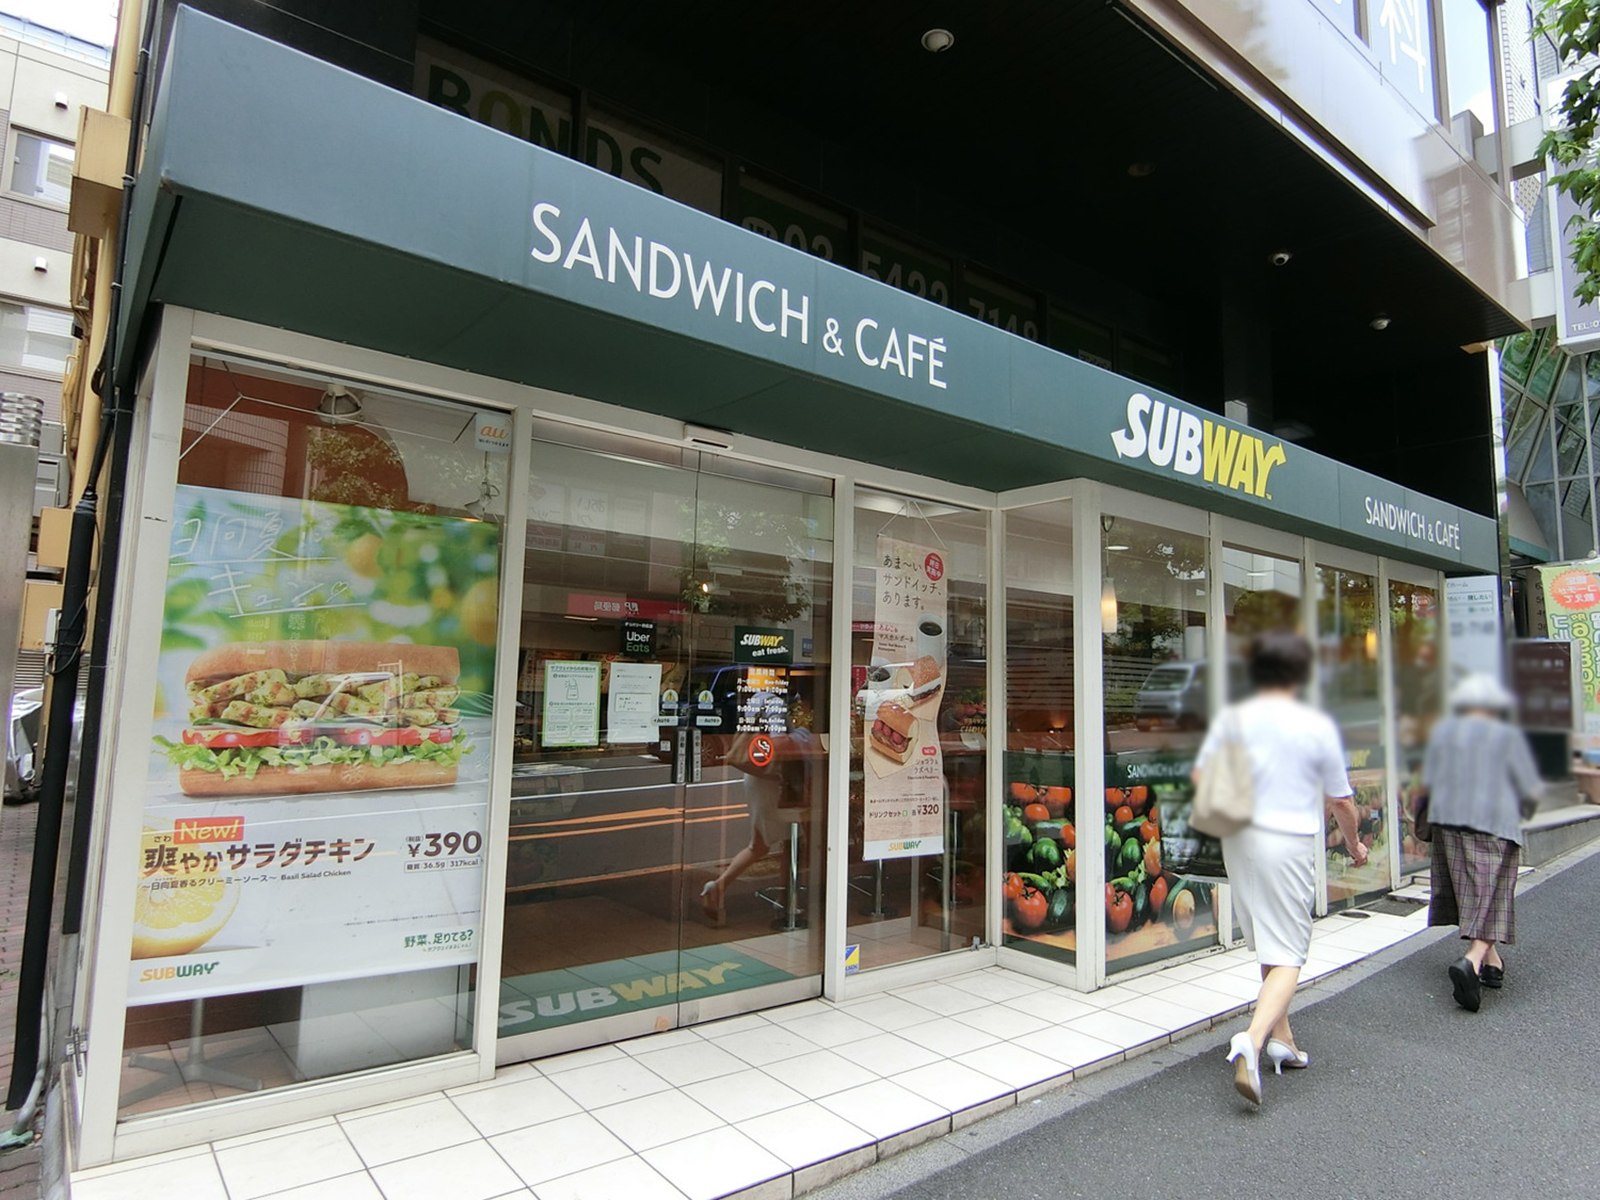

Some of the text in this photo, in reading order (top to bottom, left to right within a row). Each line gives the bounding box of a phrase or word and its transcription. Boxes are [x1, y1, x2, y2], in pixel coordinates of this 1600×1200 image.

[530, 201, 948, 389] SANDWICH & CAFÉ
[1110, 392, 1287, 499] SUBWAY
[1364, 495, 1461, 552] SANDWICH & CAFÉ
[626, 631, 651, 642] Uber
[740, 634, 784, 647] SUBWAY
[626, 642, 650, 653] Eats
[752, 649, 766, 657] eat
[179, 819, 240, 841] New!
[407, 830, 482, 858] ¥390
[888, 840, 922, 851] SUBWAY
[142, 838, 376, 877] 爽やかサラダチキン
[281, 873, 300, 881] Basil
[323, 869, 352, 877] Chicken
[404, 929, 474, 949] 野菜、足りてる?
[139, 961, 220, 982] SUBWAY
[498, 961, 743, 1029] SUBWAY
